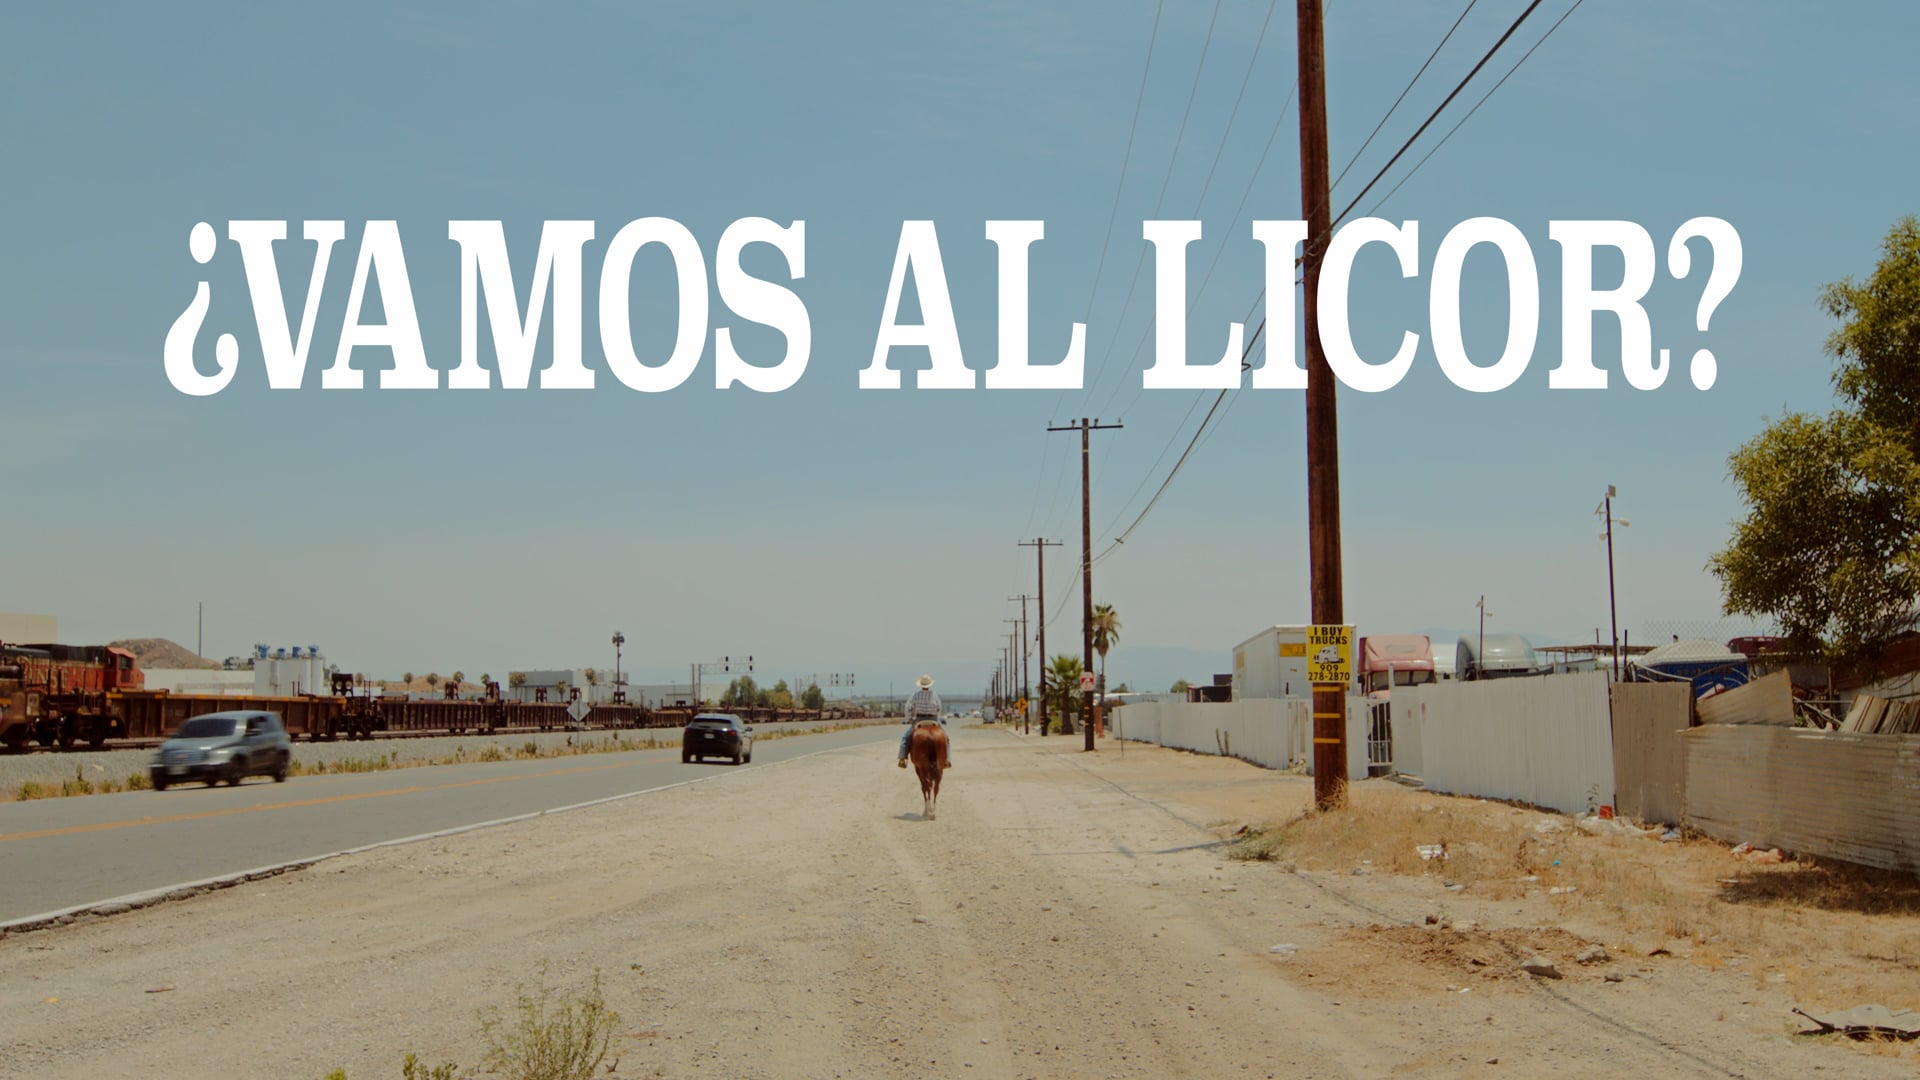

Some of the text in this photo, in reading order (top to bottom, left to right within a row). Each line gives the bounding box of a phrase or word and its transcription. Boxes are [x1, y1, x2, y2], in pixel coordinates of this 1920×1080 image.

[1314, 627, 1343, 635] I BUY
[1310, 636, 1347, 645] TRUCKS
[1308, 672, 1350, 680] 278-2870
